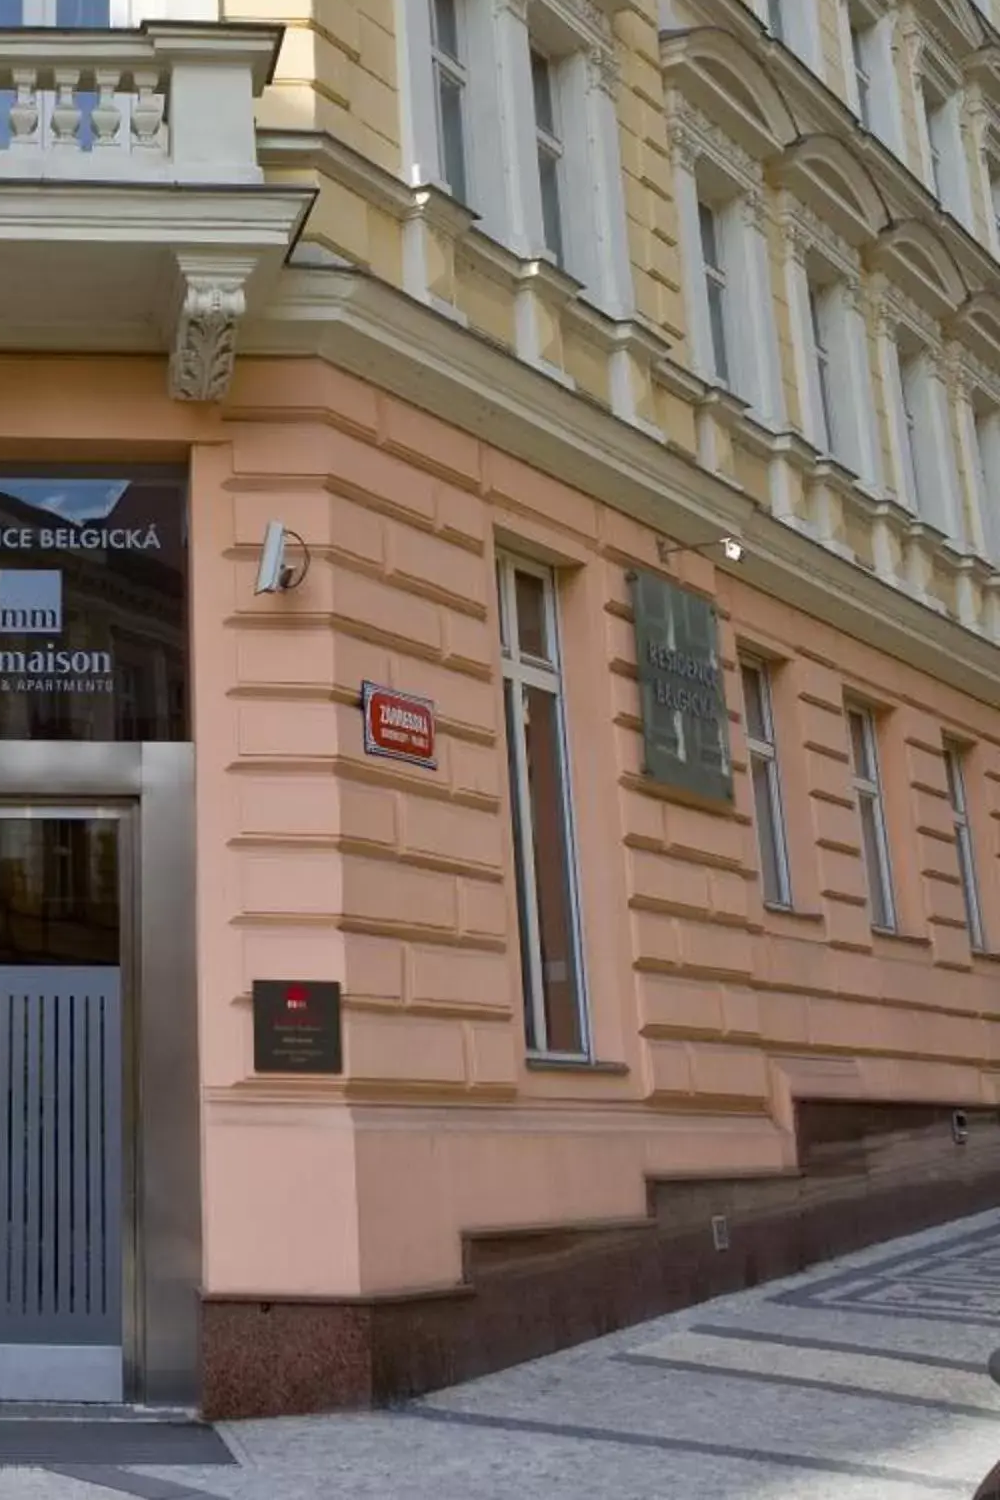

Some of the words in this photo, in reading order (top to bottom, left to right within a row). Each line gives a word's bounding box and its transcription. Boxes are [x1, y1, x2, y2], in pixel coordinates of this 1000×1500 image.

[39, 523, 162, 550] BELGICKÁ
[0, 607, 59, 629] mm
[16, 678, 114, 693] APARTMENTS
